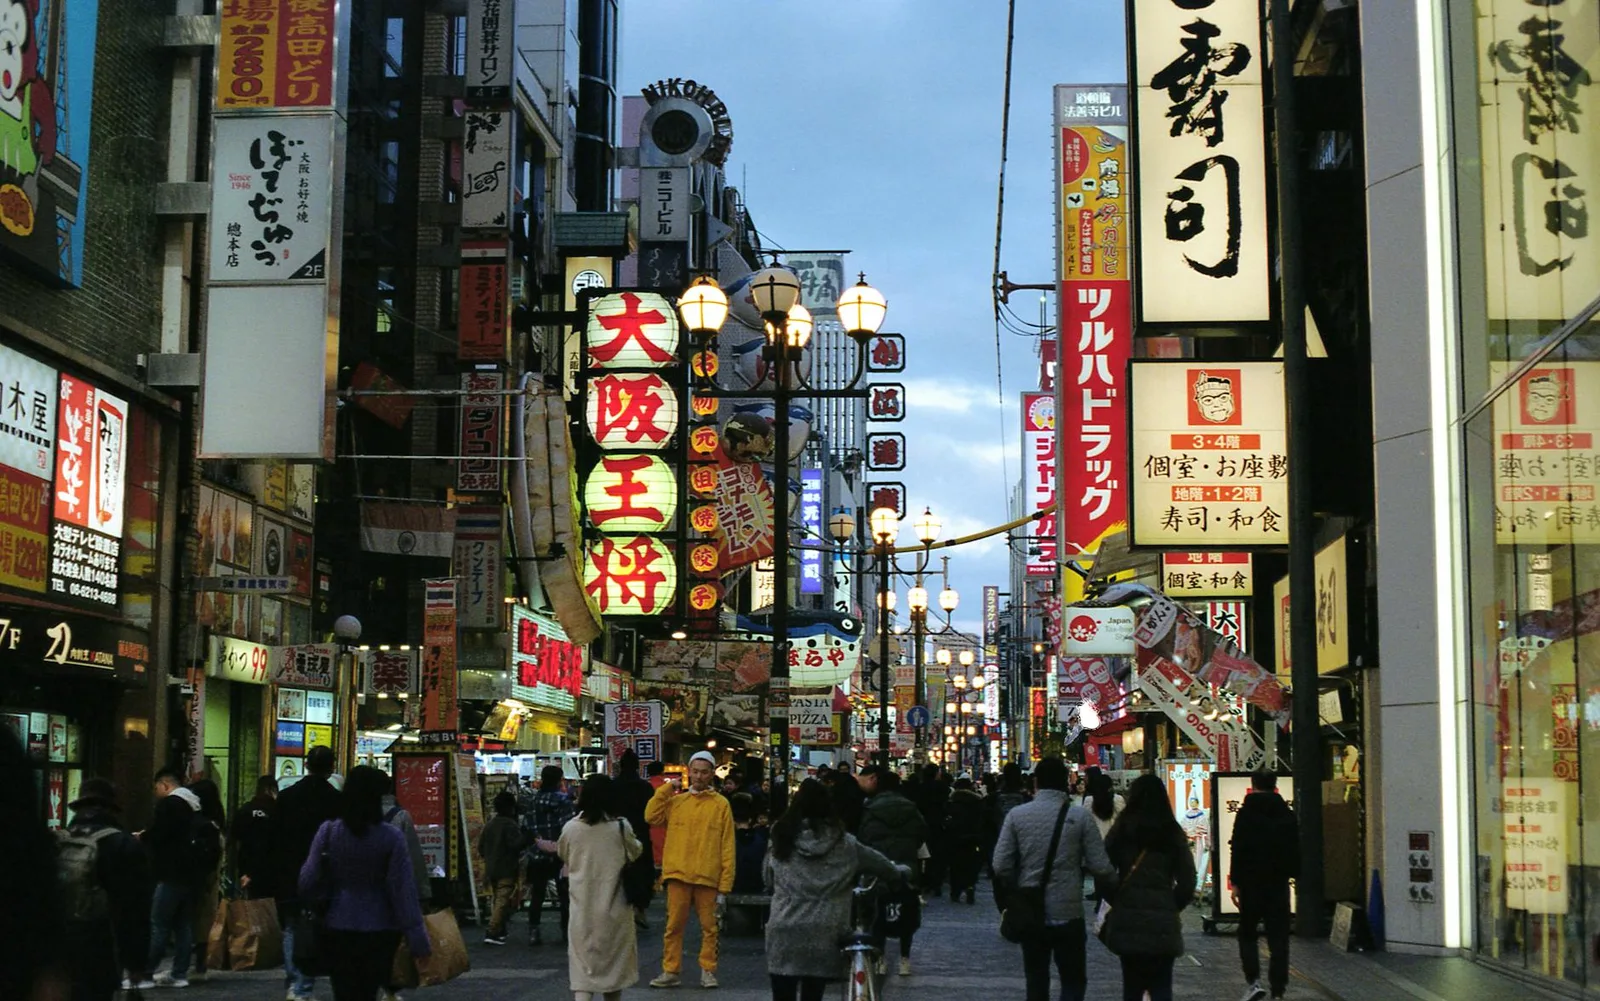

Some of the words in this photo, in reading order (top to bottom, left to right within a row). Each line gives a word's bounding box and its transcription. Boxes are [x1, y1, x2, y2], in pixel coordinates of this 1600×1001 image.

[1150, 0, 1252, 279] 寿司
[228, 172, 251, 181] Since
[463, 160, 505, 199] Leaf
[304, 265, 322, 277] 2F
[0, 381, 48, 433] 木屋
[1077, 288, 1118, 521] ツルハドラッグ
[584, 292, 676, 614] 大阪王将
[1160, 505, 1283, 532] 寿司・和食
[1167, 570, 1248, 589] 個室・和食
[615, 704, 652, 734] 薬
[790, 714, 829, 725] PIZZA
